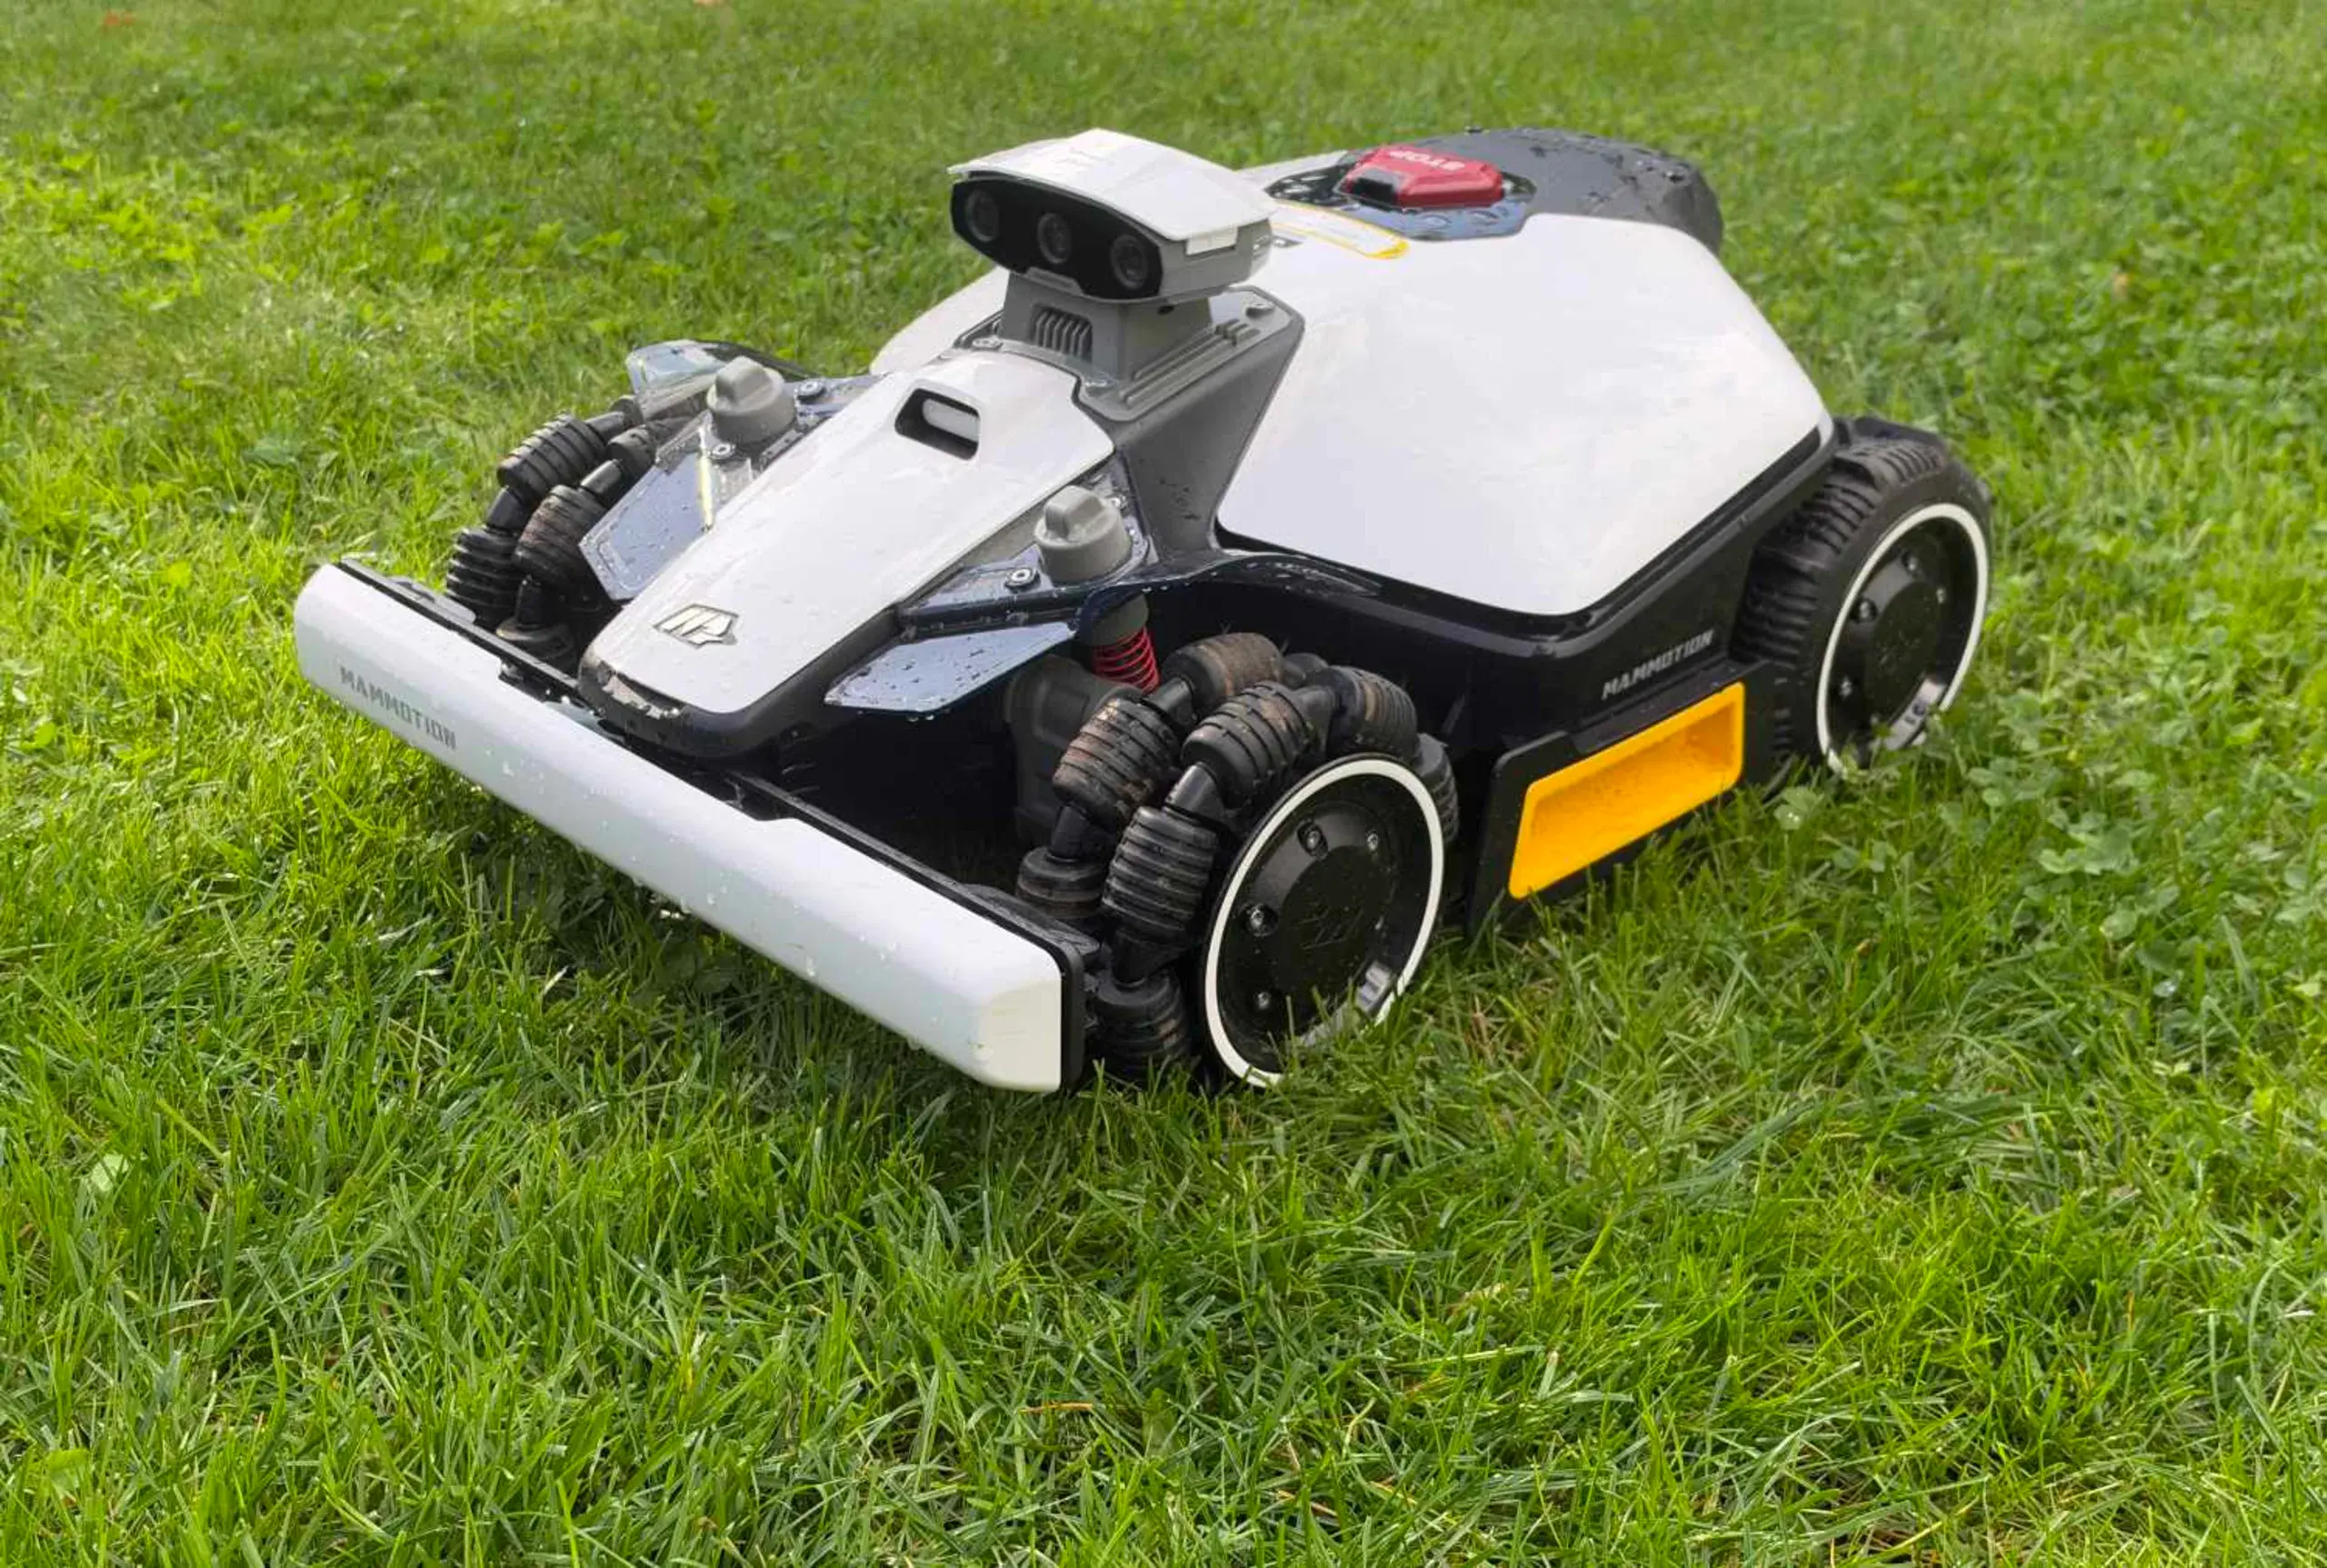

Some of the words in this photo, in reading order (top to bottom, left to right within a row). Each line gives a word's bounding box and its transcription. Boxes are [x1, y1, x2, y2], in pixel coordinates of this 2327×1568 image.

[1388, 149, 1466, 172] STOP
[1601, 628, 1714, 701] MAMMOTION
[339, 665, 456, 750] MAMMOTION
